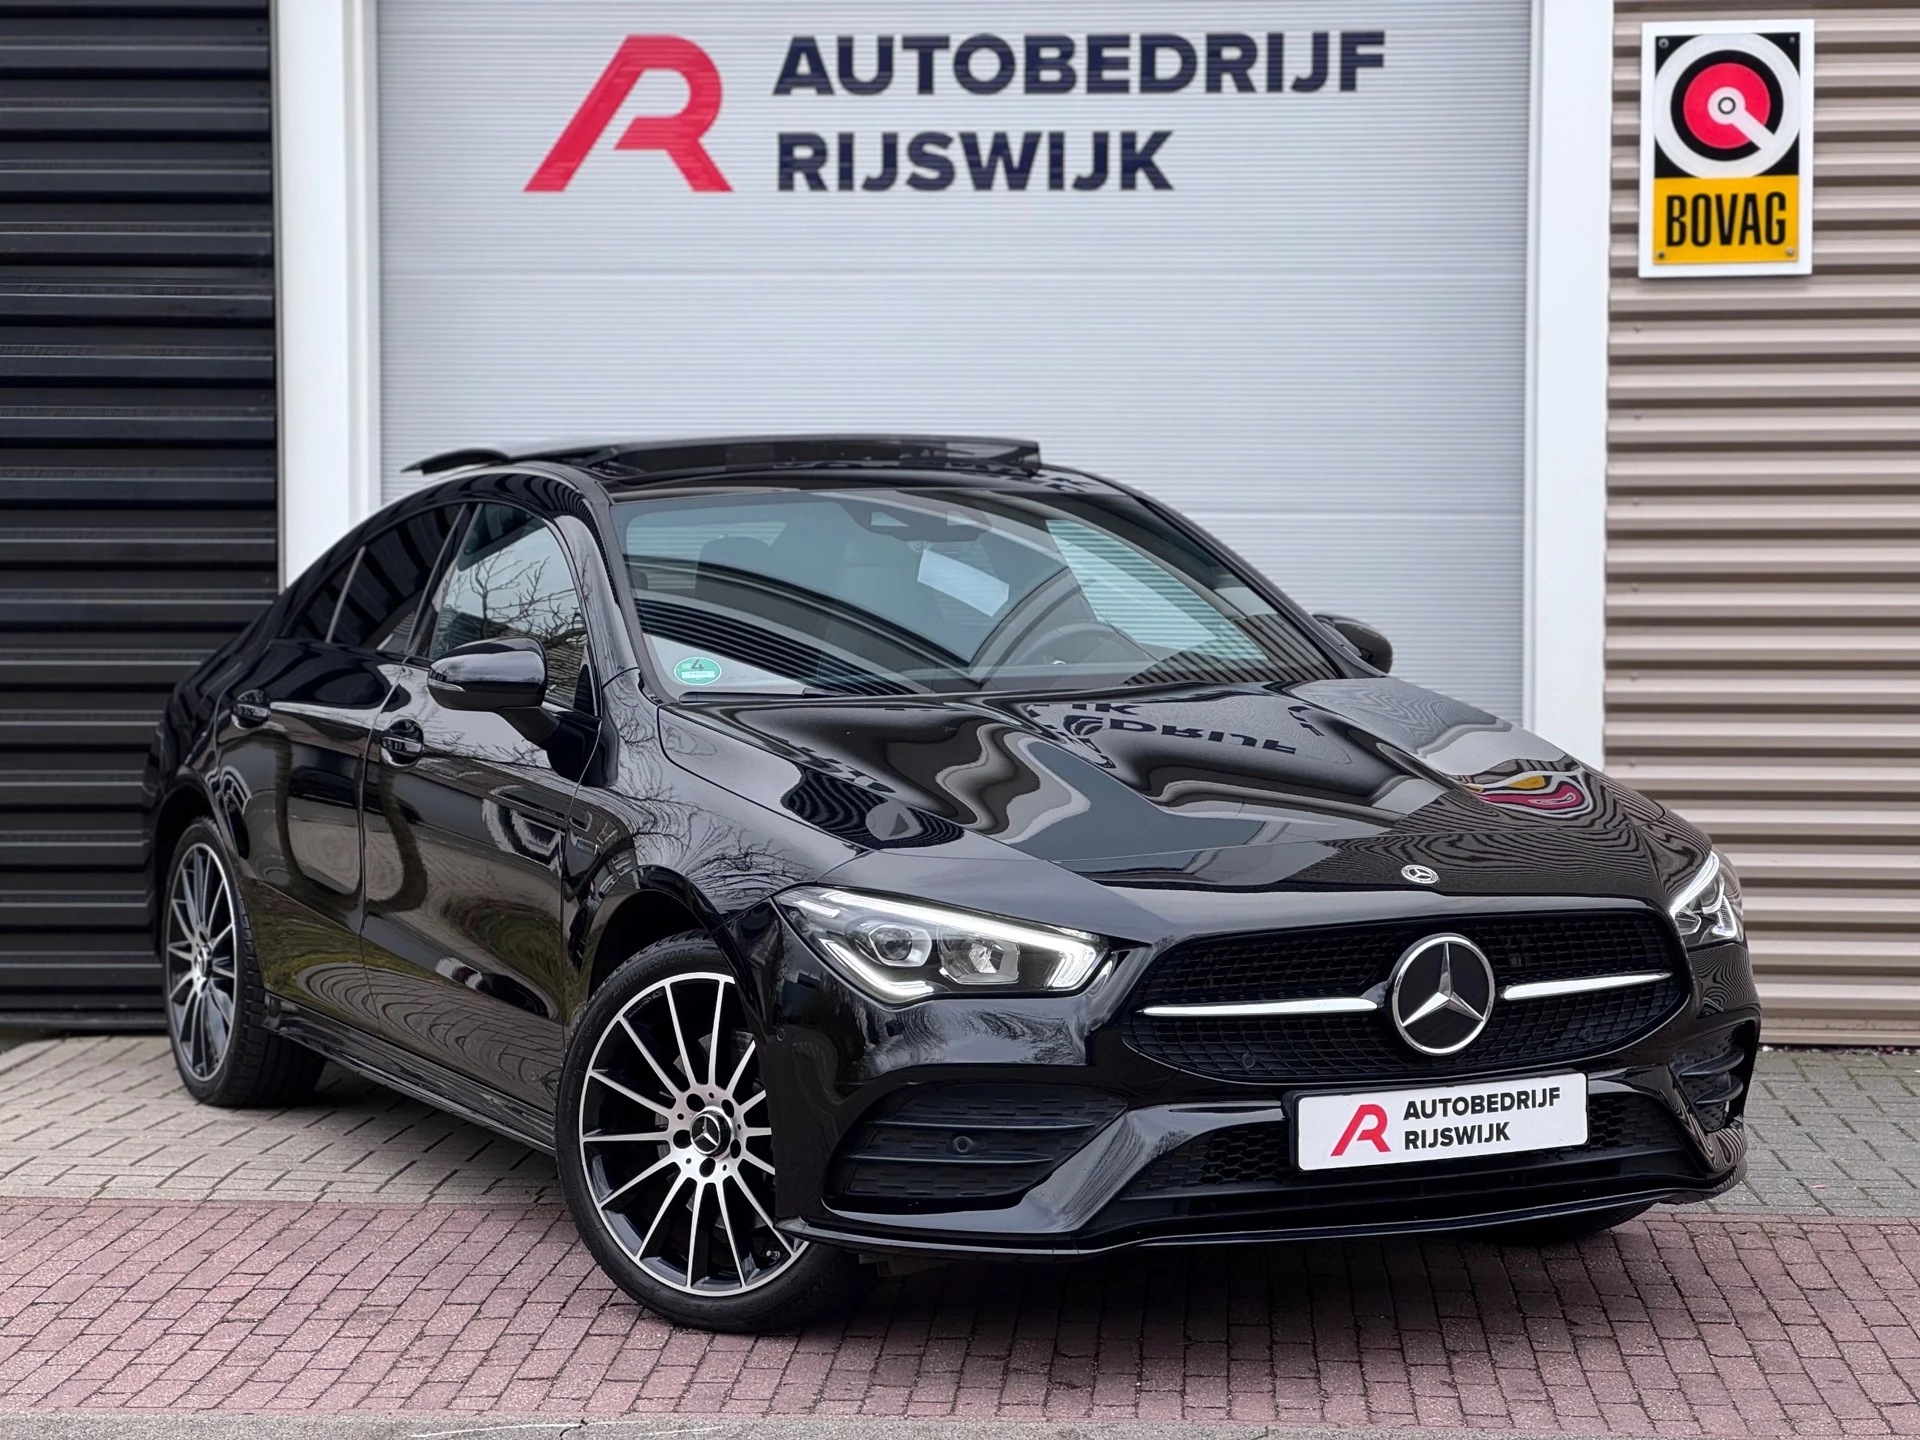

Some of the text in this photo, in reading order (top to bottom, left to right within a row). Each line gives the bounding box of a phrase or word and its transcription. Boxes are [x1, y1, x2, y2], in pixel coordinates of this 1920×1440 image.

[772, 31, 1386, 96] AUTOBEDRIJF
[777, 130, 1174, 192] RIJSWIJK
[1666, 191, 1787, 247] BOVAG
[1403, 1087, 1561, 1121] AUTOBEDRIJF
[1404, 1121, 1511, 1151] RIJSWIJK
